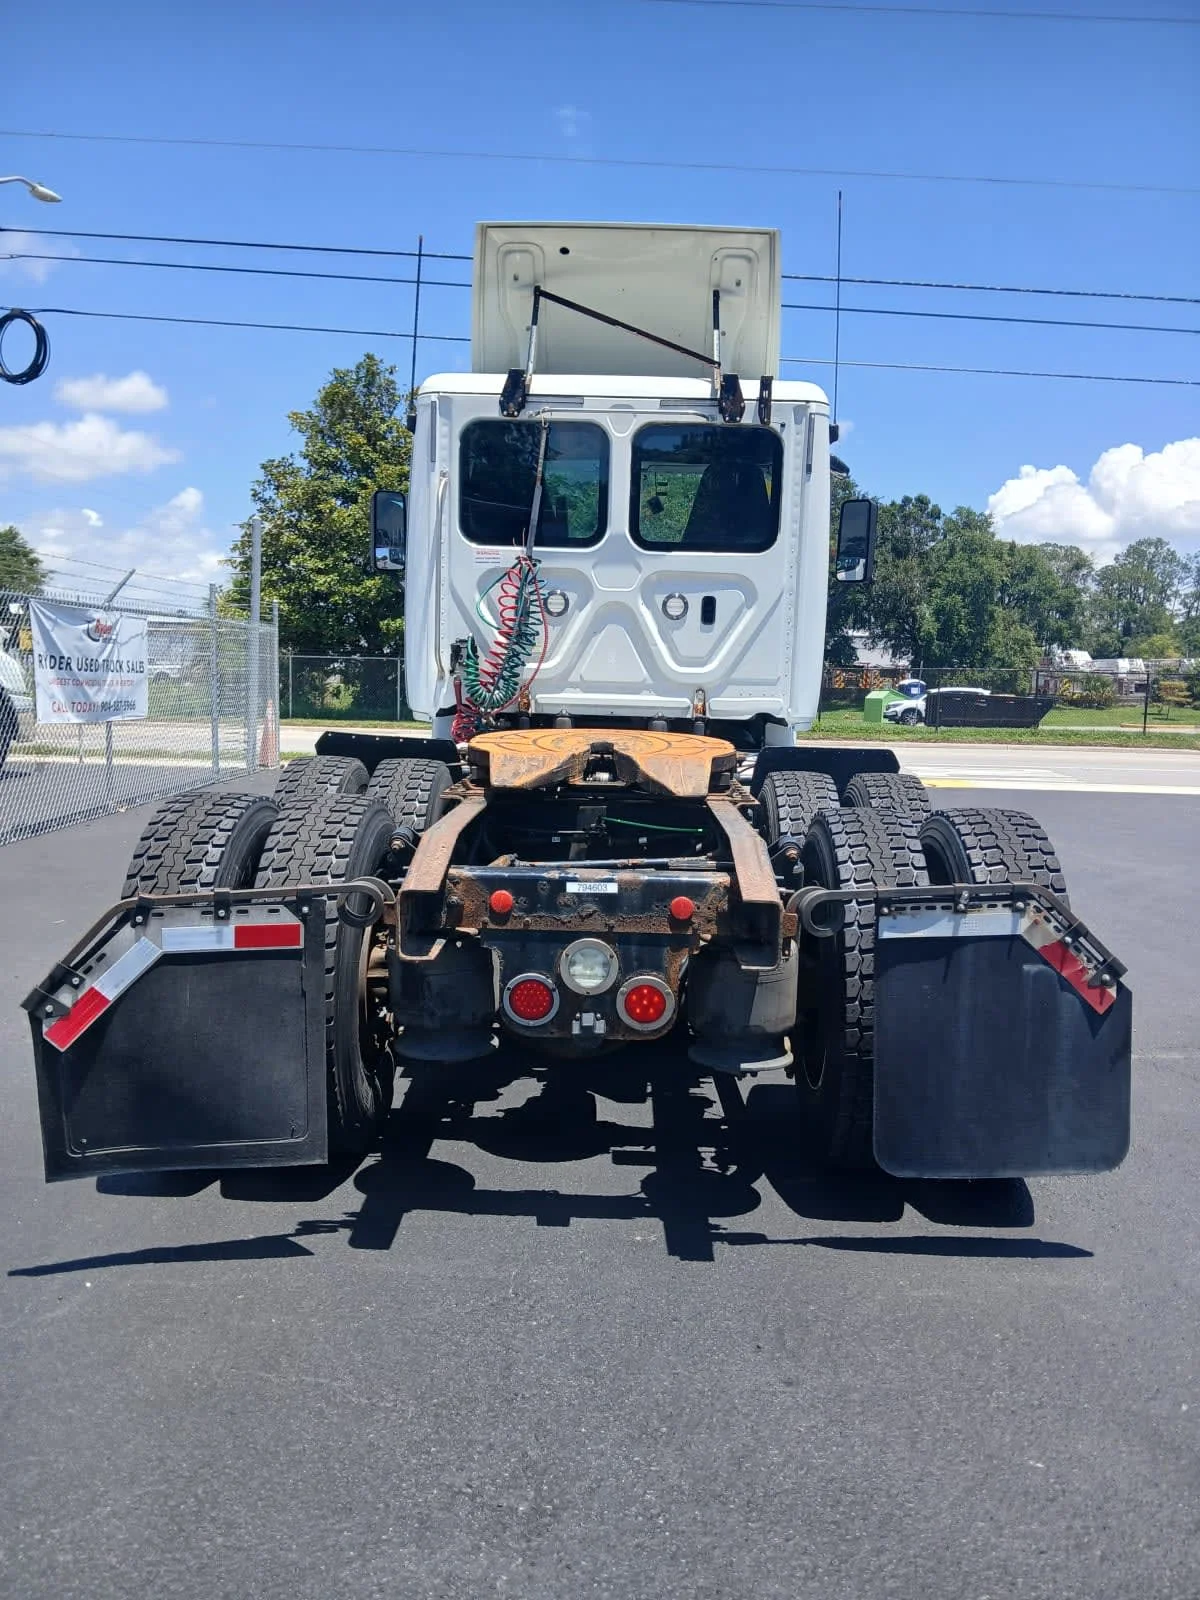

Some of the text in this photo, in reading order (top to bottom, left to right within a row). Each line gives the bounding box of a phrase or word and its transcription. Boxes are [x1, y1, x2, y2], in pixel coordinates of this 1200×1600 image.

[38, 654, 145, 674] RYDER USED TRUCK SALES
[51, 701, 69, 713] CALL
[577, 883, 608, 891] 794603
